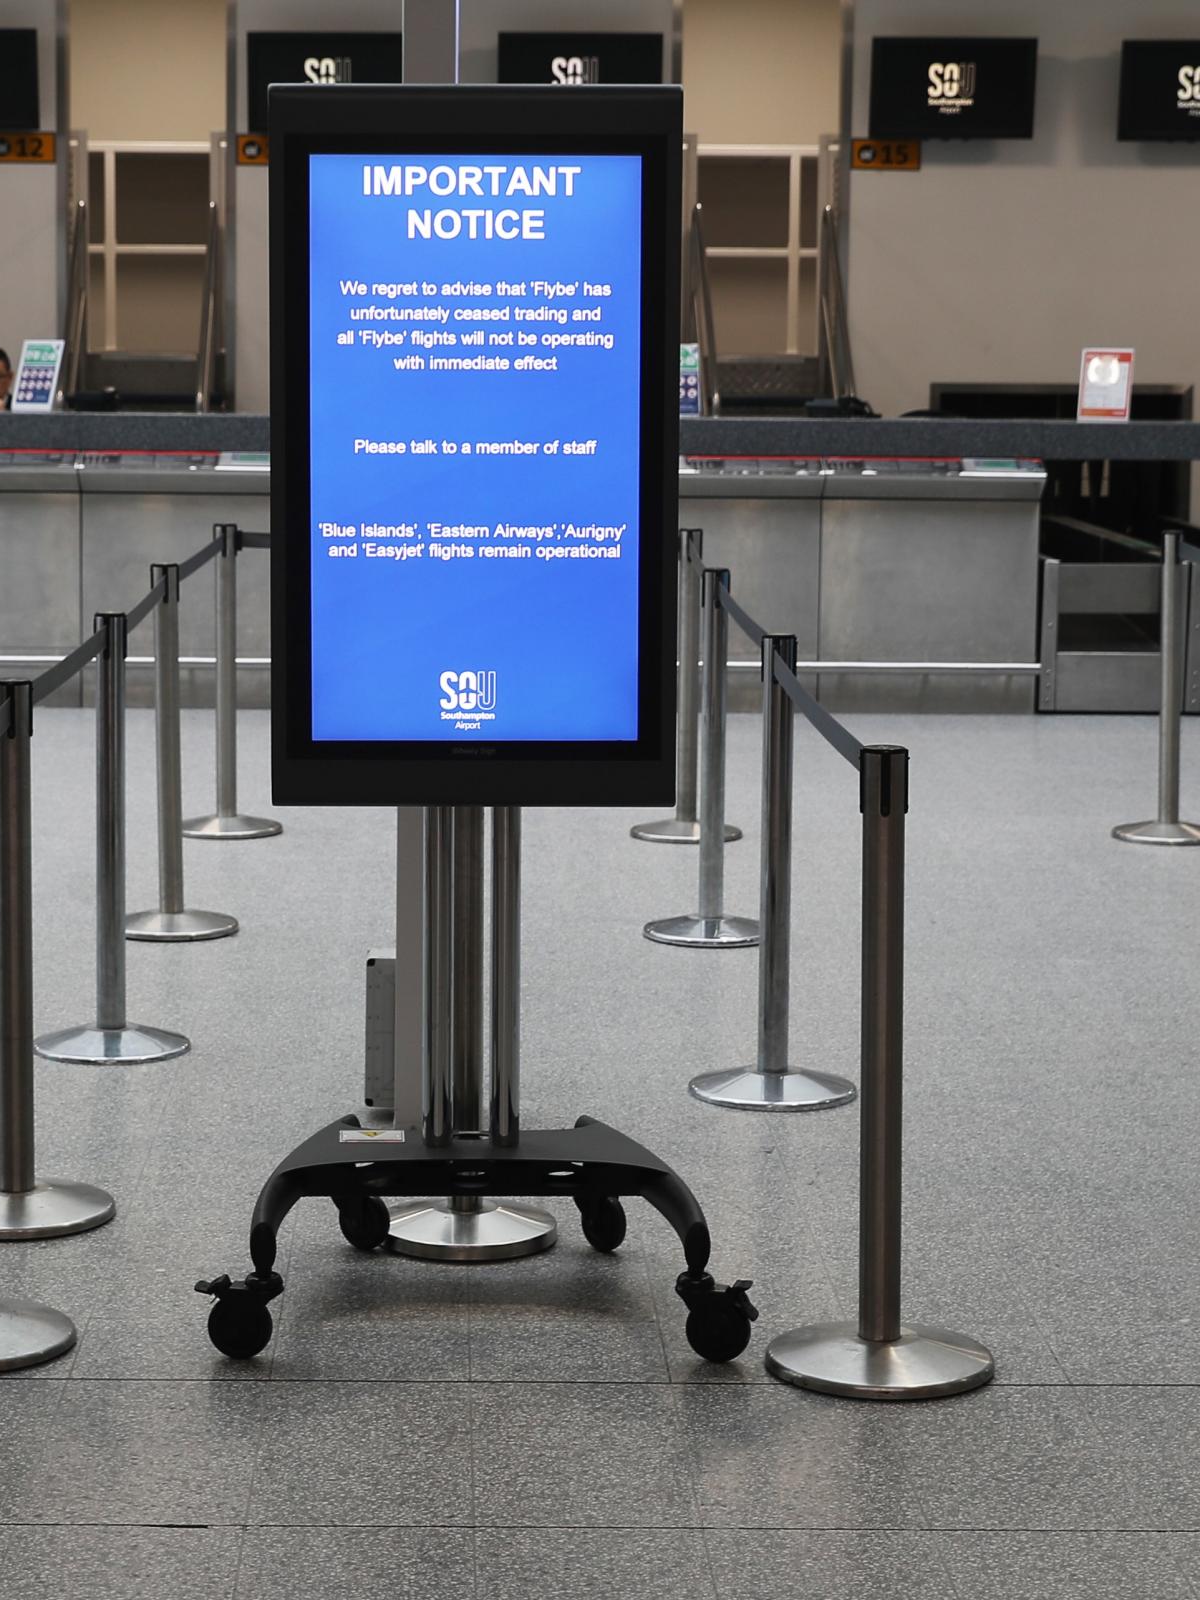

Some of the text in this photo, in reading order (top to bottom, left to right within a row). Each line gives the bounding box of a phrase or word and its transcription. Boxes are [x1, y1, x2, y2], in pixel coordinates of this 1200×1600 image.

[16, 138, 43, 158] 12
[881, 145, 908, 165] 15
[363, 165, 582, 197] IMPORTANT
[407, 208, 546, 240] NOTICE
[339, 280, 612, 300] We regret to advise that 'Flybe' has
[350, 305, 601, 325] unfortunately ceased trading and
[336, 329, 614, 350] all 'Flybe' flights will not be operating
[393, 354, 558, 371] with immediate effect
[354, 438, 598, 455] Please talk to a member of staff
[318, 522, 357, 538] 'Blue
[360, 522, 422, 540] Islands',
[426, 522, 490, 538] 'Eastern
[328, 542, 621, 561] and 'Easyjet' flights remain operational
[439, 670, 497, 711] SOU
[440, 711, 496, 721] Southampton
[454, 720, 481, 731] Airport
